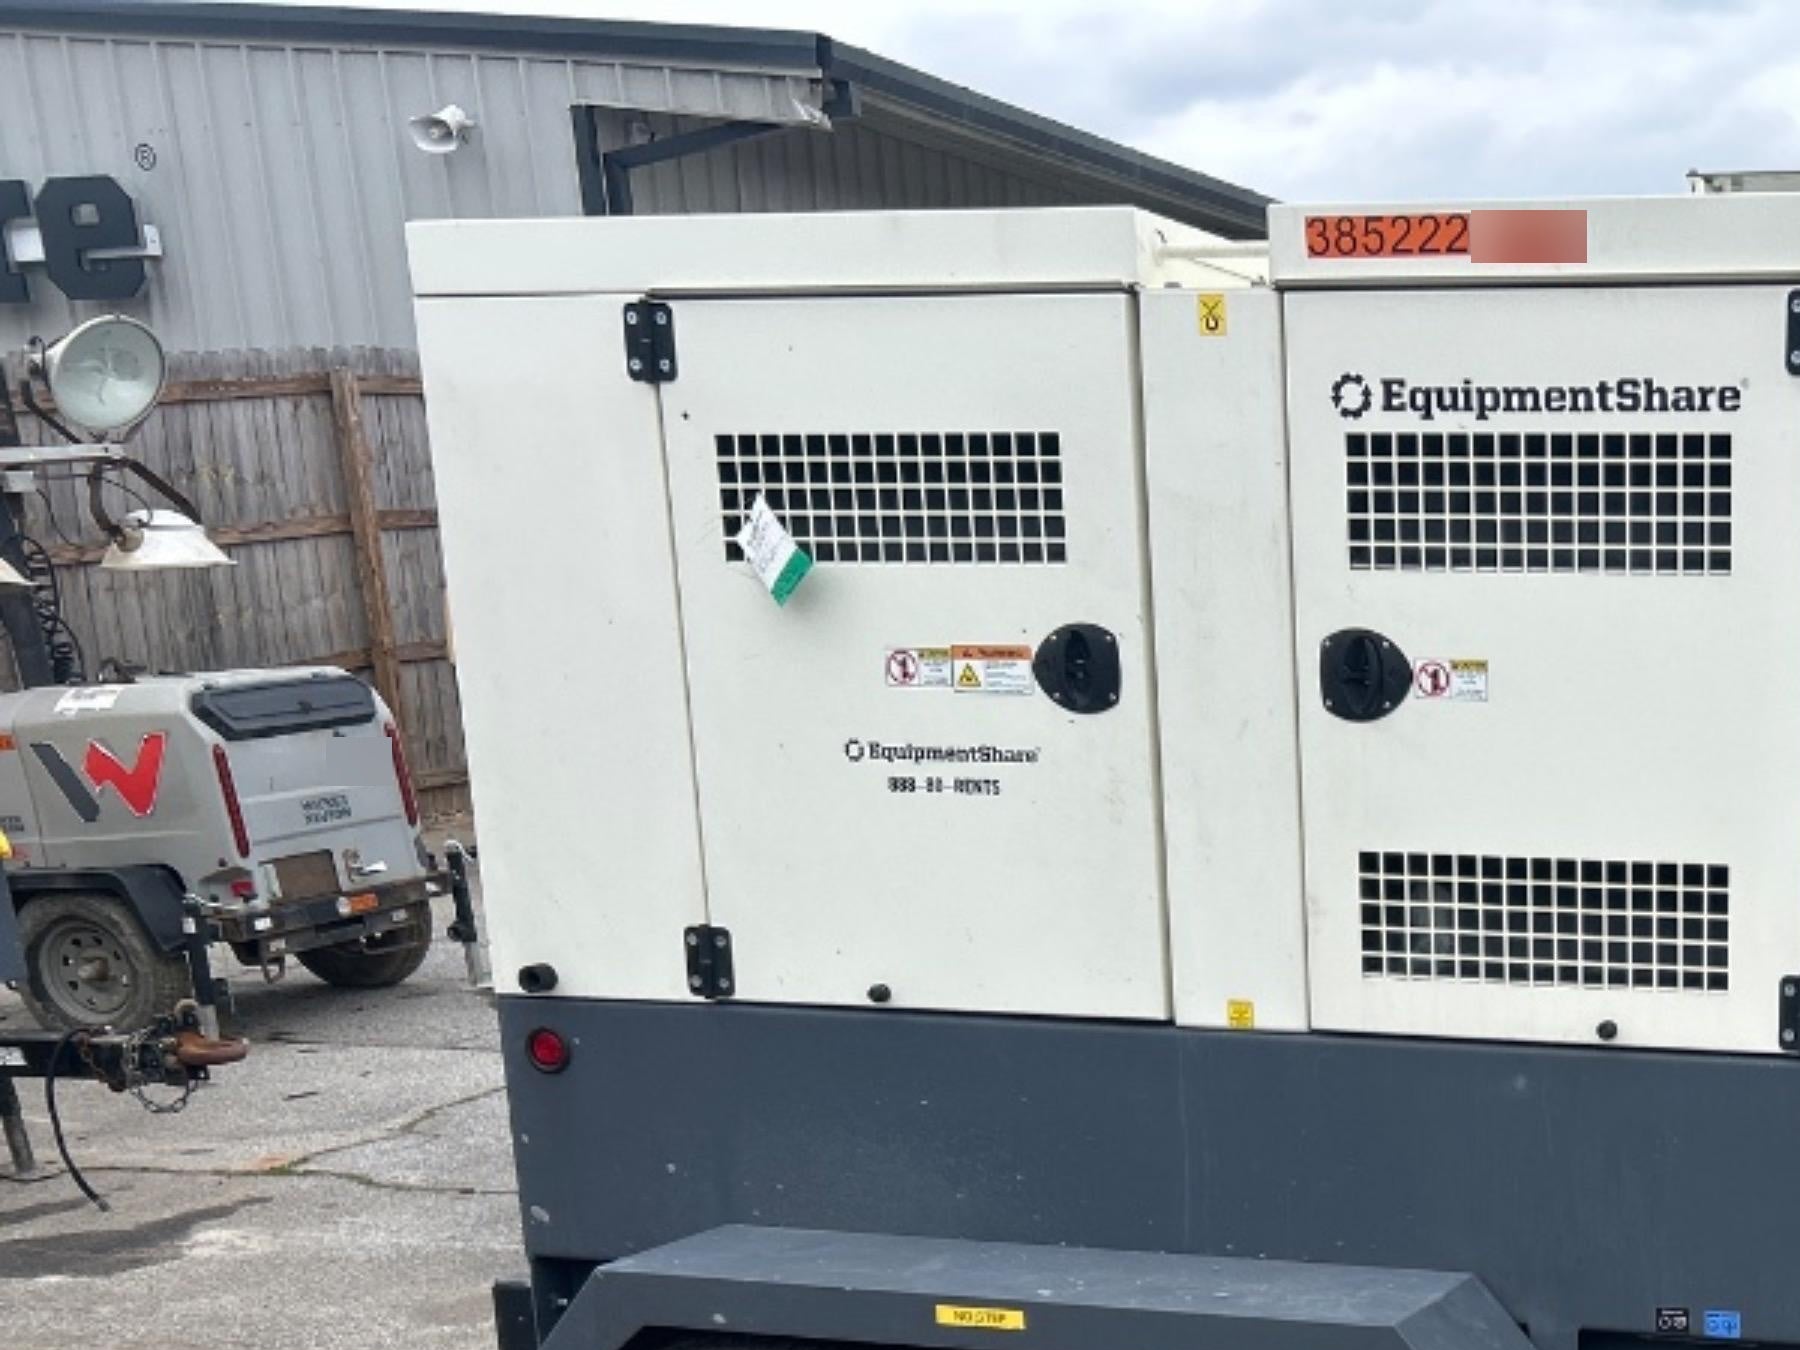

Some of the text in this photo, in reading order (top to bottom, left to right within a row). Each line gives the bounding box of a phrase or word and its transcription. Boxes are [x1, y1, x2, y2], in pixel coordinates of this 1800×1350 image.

[1306, 214, 1469, 257] 385222
[1381, 378, 1742, 421] EquipmentShare
[867, 741, 1039, 766] EquipmentShare
